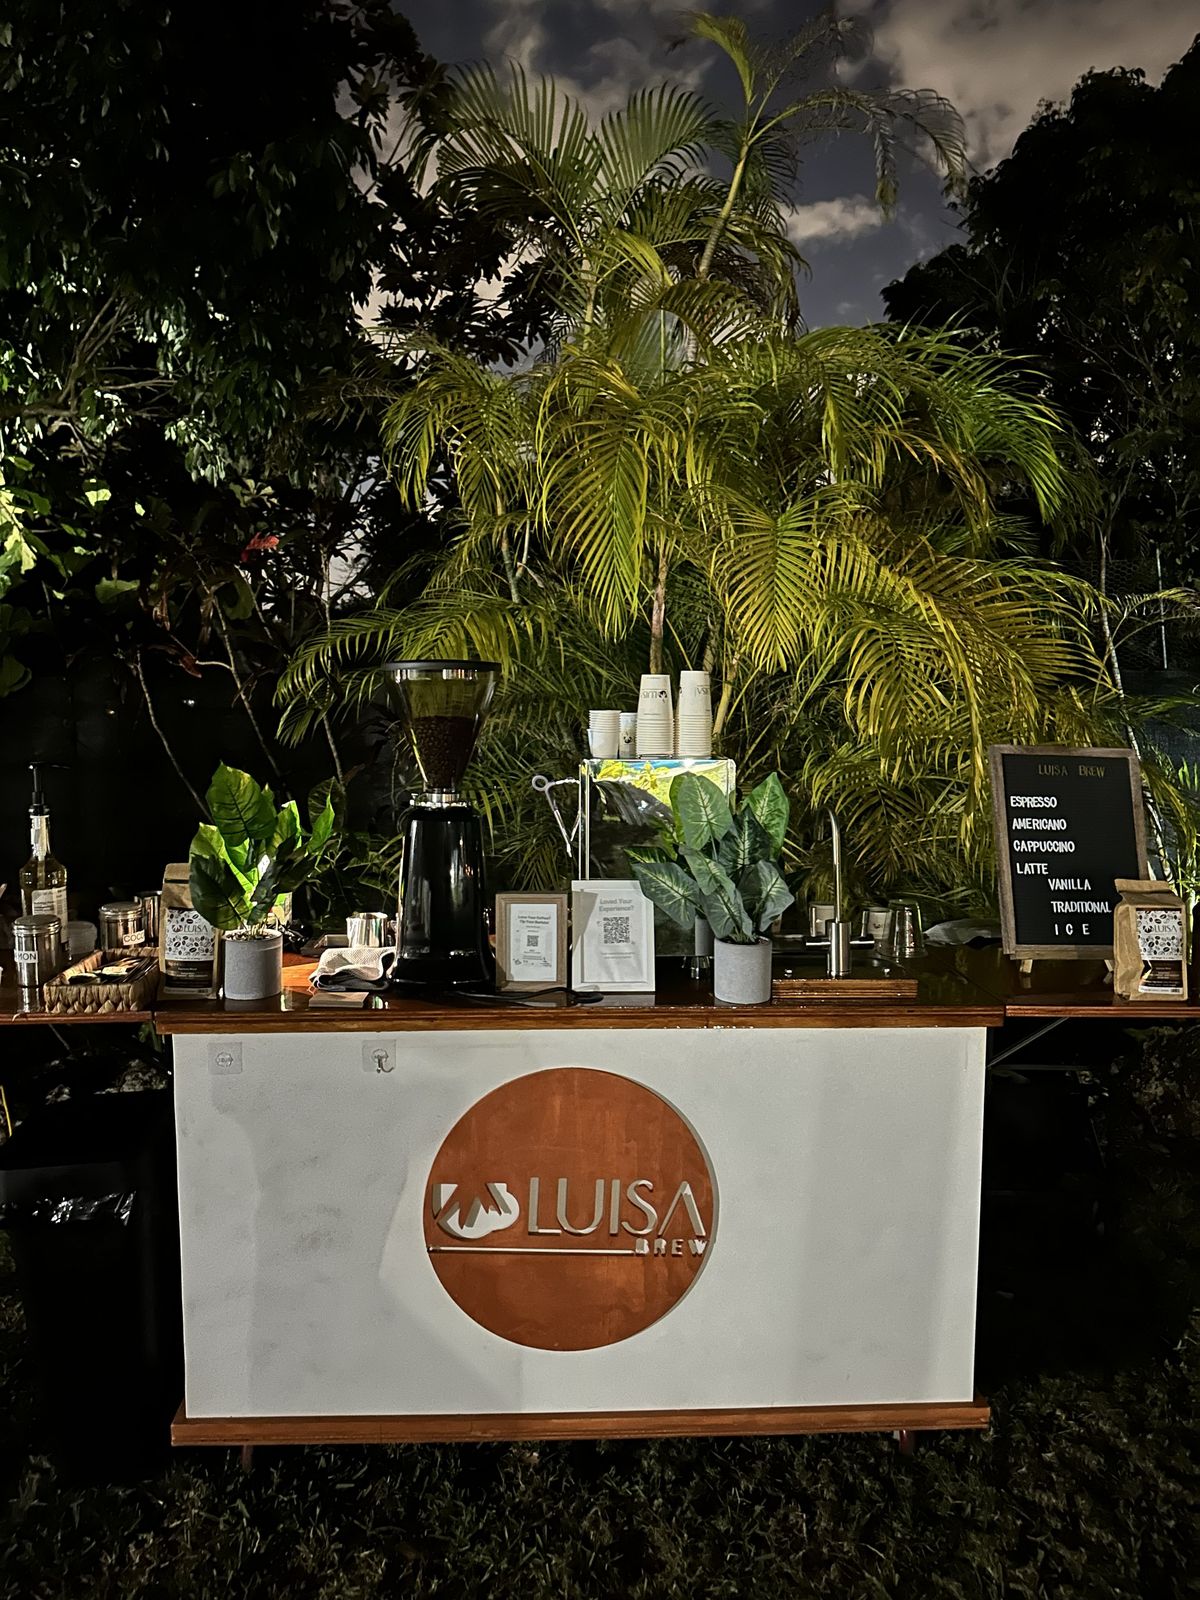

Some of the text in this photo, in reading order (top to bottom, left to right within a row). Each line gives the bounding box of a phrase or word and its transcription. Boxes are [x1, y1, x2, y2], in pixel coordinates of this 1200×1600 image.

[1038, 763, 1105, 778] LUISA BREW
[1010, 795, 1058, 808] ESPRESSO
[1012, 818, 1067, 831] AMERICANO
[1013, 840, 1075, 853] CAPPUCCINO
[1016, 862, 1049, 875] LATTE
[1048, 878, 1092, 891] VANILLA
[1050, 901, 1113, 913] TRADITIONAL
[183, 924, 208, 933] LUISA
[1153, 924, 1178, 933] LUISA
[527, 1176, 707, 1237] LUISA
[635, 1237, 710, 1257] BREW
